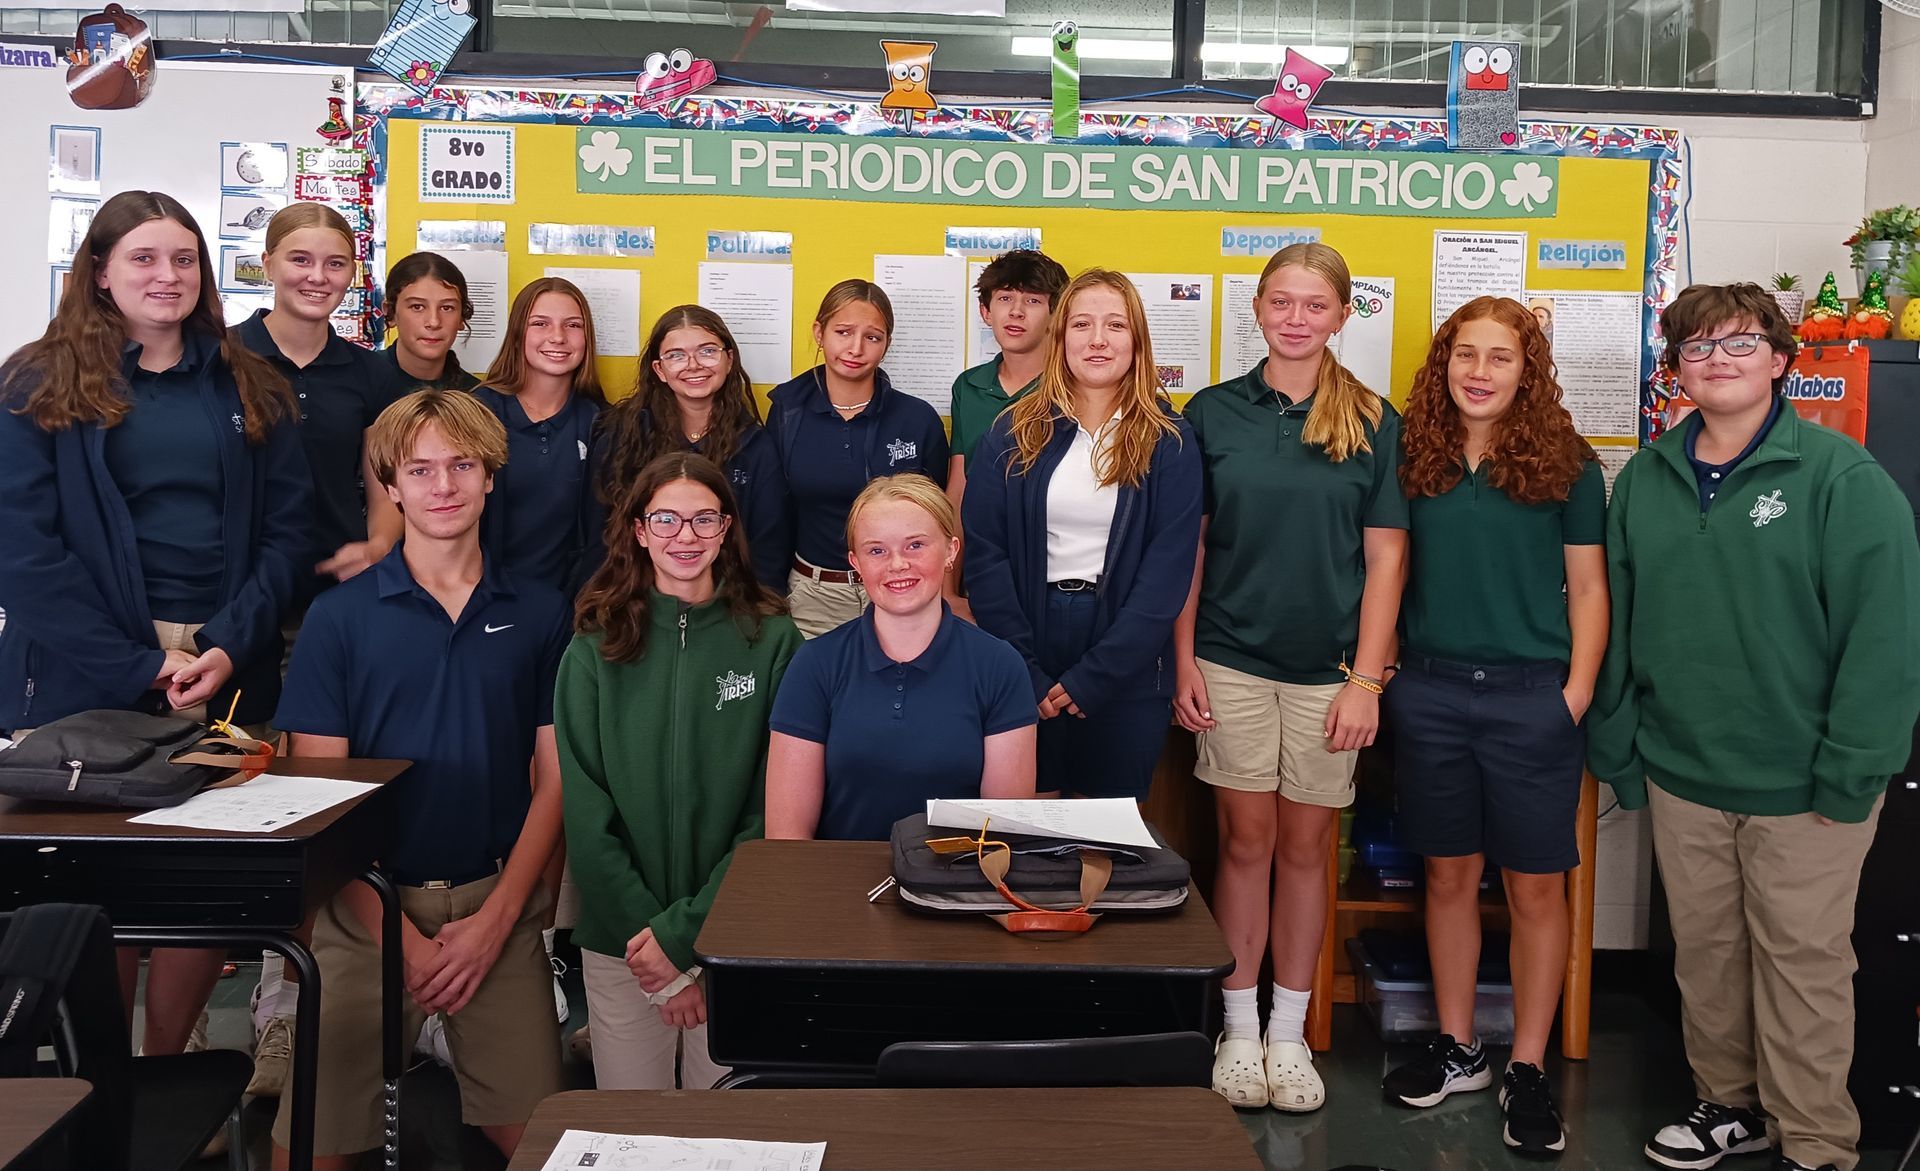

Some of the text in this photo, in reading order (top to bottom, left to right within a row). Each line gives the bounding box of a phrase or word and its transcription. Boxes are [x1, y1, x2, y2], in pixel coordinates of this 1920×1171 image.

[449, 138, 484, 156] 8vo
[432, 170, 503, 190] GRADO
[645, 136, 1496, 211] EL PERIODICO DE SAN PATRICIO
[1539, 244, 1624, 268] Religión
[895, 444, 916, 460] IRISH
[724, 677, 756, 701] IRISH
